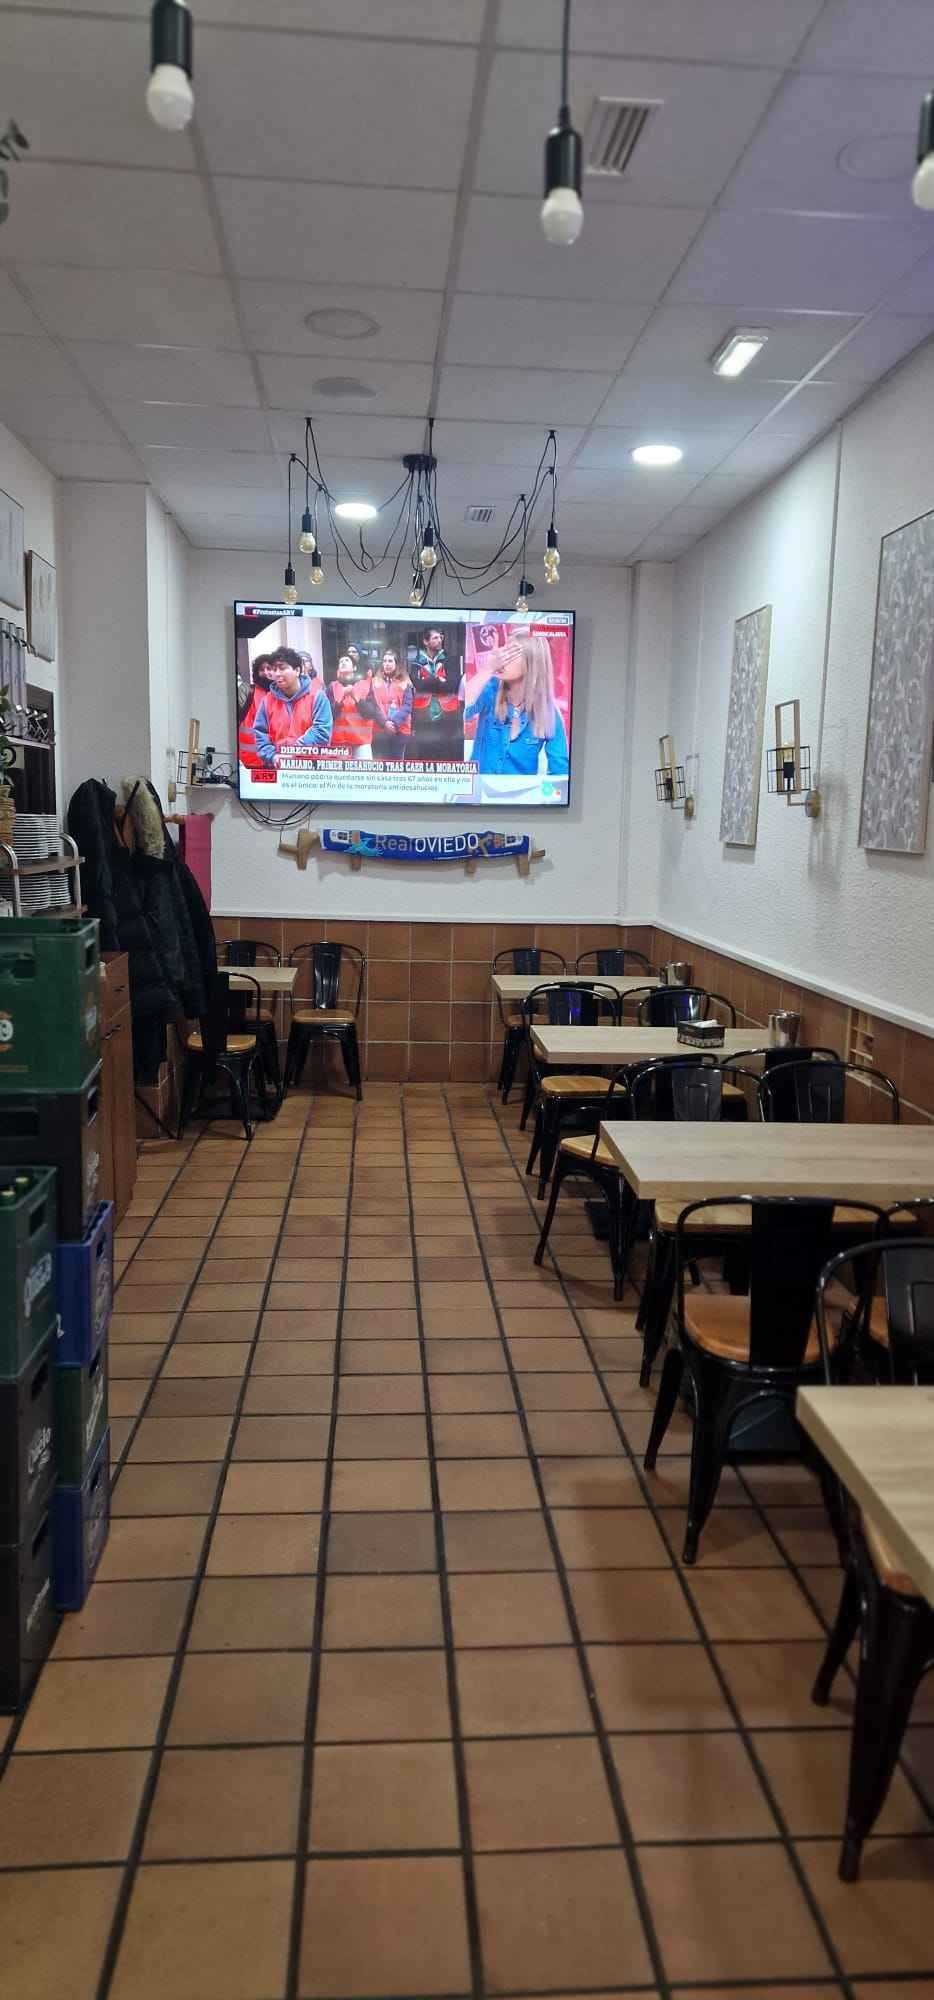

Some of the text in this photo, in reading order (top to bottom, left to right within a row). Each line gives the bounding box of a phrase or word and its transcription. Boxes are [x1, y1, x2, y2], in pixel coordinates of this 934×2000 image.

[280, 746, 349, 756] DIRECTO Madrid
[280, 758, 477, 773] MARIANO, PRIMER DESAHUCIO TRAS CAER LA MORATORIA
[281, 772, 309, 780] Mariano
[375, 834, 479, 854] Real OVIEDO
